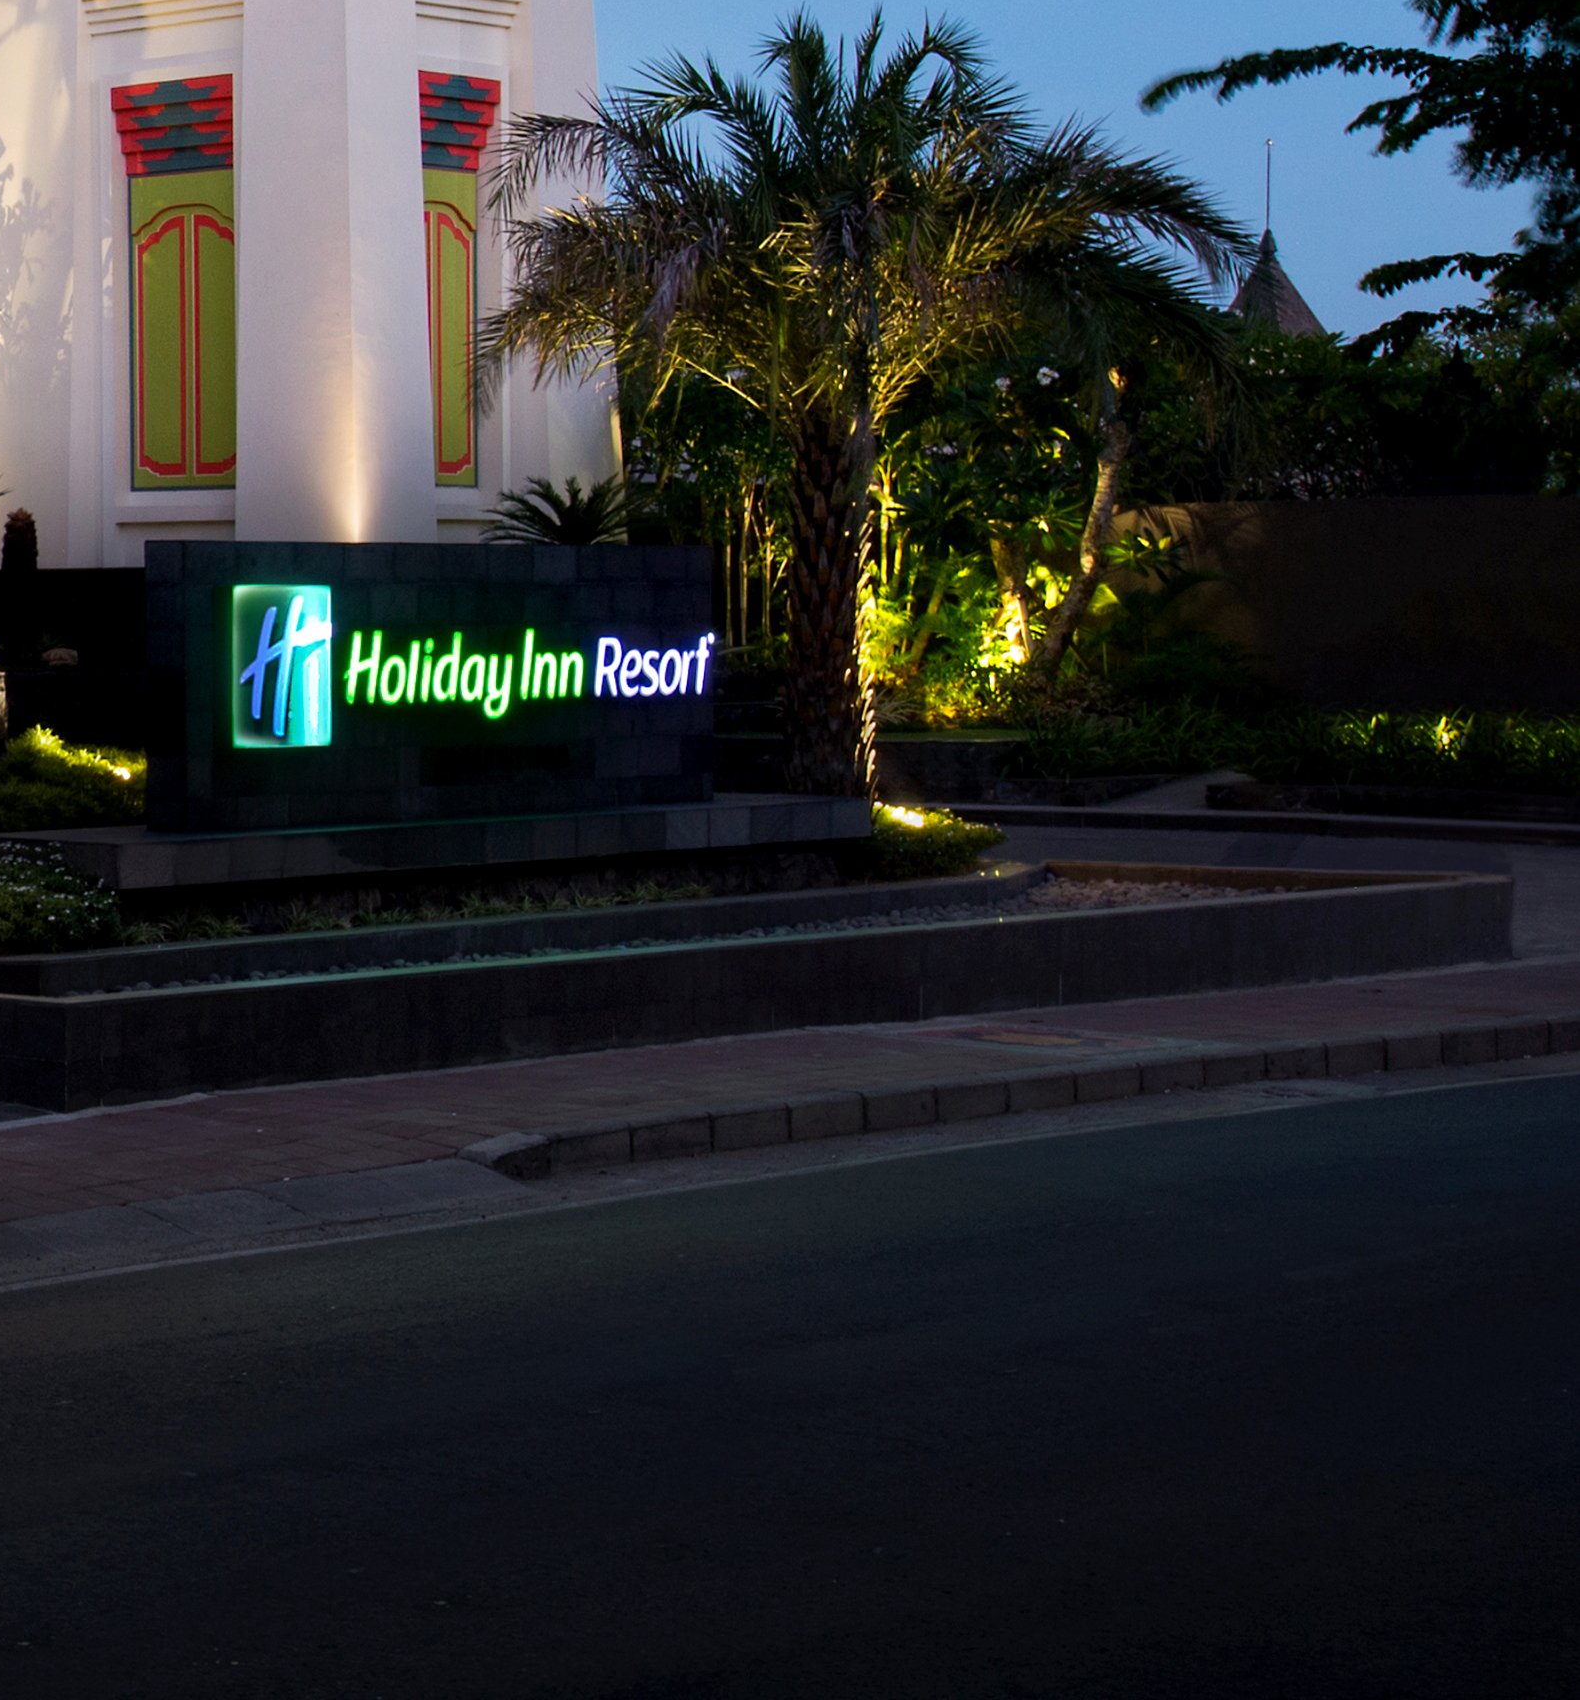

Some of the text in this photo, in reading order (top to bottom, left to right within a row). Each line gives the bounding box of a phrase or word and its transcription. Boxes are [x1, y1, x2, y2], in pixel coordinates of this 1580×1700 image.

[344, 628, 709, 719] Holiday Inn Resort
